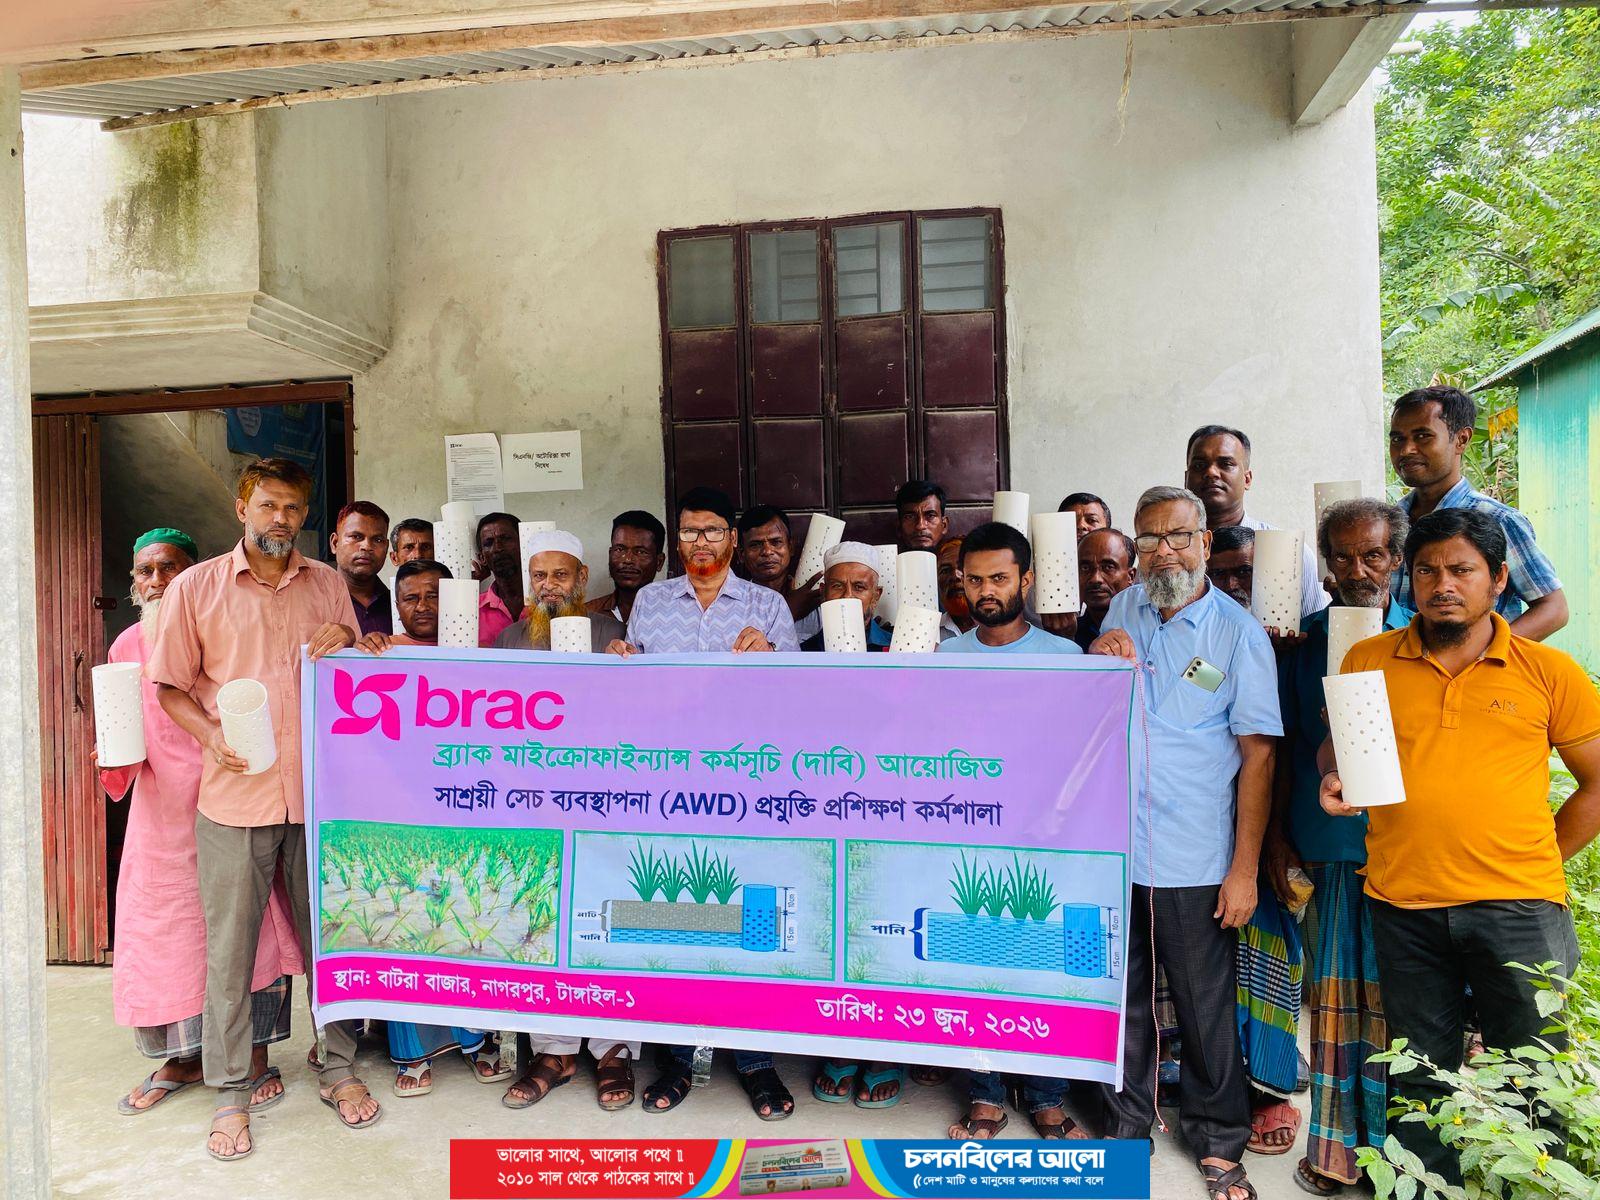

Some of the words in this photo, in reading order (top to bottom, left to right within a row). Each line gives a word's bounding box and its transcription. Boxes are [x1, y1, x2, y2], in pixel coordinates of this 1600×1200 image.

[415, 675, 565, 731] brac
[433, 742, 493, 769] ব্র্যাক
[501, 738, 693, 772] মাইক্রোফাইন্যান্স
[700, 742, 783, 781] কর্মসূচি
[791, 745, 866, 782] (দাবি)
[876, 748, 1005, 781] আয়োজিত
[434, 780, 498, 811] সাশ্রয়ী
[506, 789, 544, 809] সেচ
[552, 790, 651, 818] ব্যবস্থাপনা
[660, 790, 747, 823] (AWD)
[755, 789, 817, 824] প্রযুক্তি
[824, 791, 907, 822] প্রশিক্ষণ
[913, 794, 1004, 827] কর্মশালা
[870, 923, 906, 936] পানি
[332, 967, 371, 993] স্থান:
[377, 966, 419, 991] বাটরা
[424, 972, 477, 998] বাজার,
[480, 977, 551, 1005] নাগরপুর,
[555, 979, 636, 1008] টাঙ্গাইল-১
[815, 993, 884, 1023] তারিখ:
[894, 1005, 926, 1029] ২৩
[932, 1007, 975, 1037] জুন,
[984, 1012, 1050, 1040] ২০২৬
